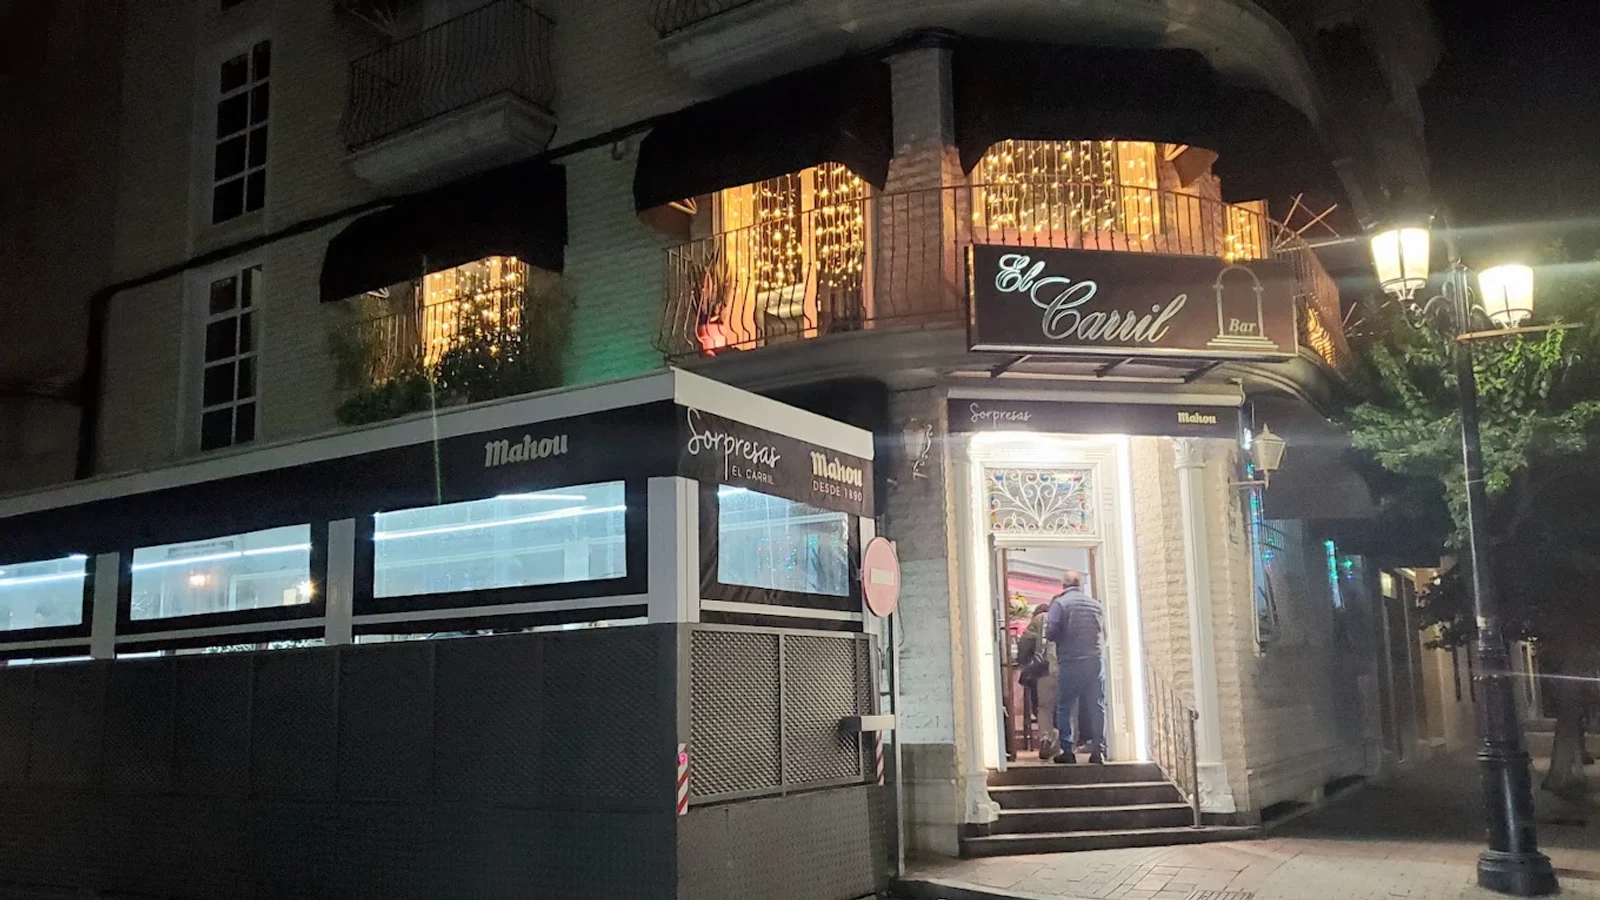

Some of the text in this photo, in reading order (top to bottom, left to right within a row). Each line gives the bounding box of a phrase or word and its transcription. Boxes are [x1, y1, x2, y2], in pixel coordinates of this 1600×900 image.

[995, 253, 1187, 343] El Carril
[1229, 317, 1257, 333] Bar
[969, 402, 1032, 429] Sorpresas
[1177, 411, 1217, 424] Mahou
[484, 434, 568, 467] Mahou
[687, 406, 781, 481] Sorpresas
[731, 464, 775, 485] EL CARRIL
[810, 450, 863, 487] Mahou
[812, 479, 863, 502] DESDE 1890
